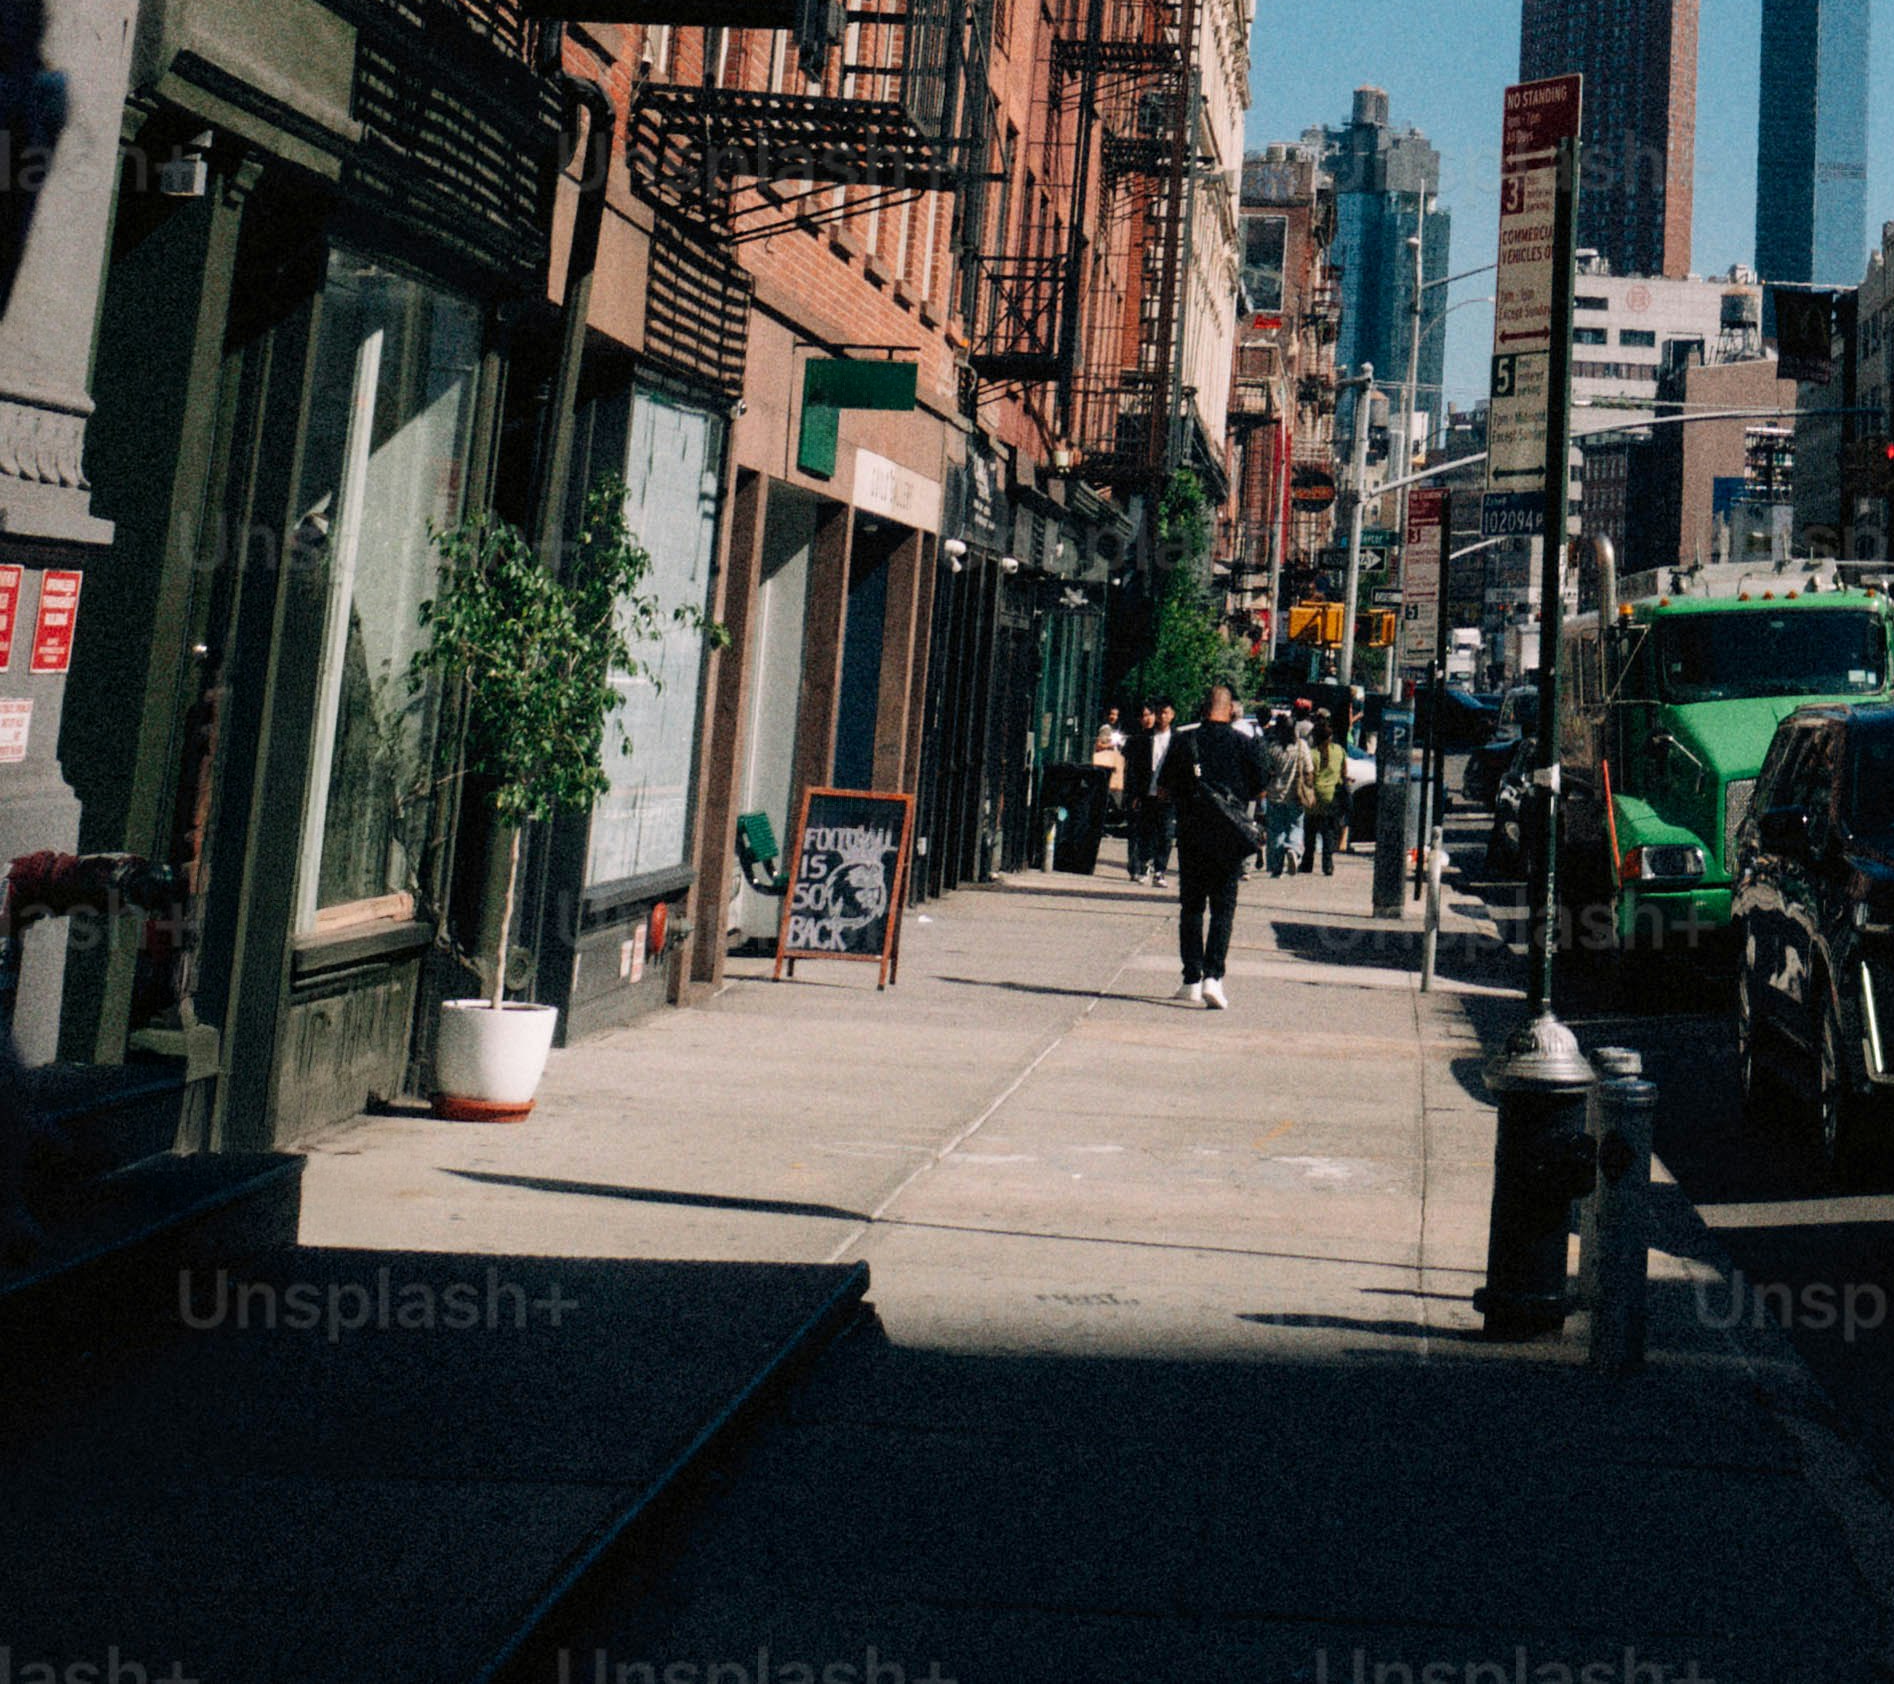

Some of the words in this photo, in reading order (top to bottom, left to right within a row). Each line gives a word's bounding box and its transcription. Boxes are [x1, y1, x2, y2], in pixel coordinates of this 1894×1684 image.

[1507, 92, 1520, 109] NO
[1522, 85, 1568, 107] STANDING
[1506, 178, 1519, 211] 3
[1502, 225, 1554, 246] COMMERCI
[1501, 246, 1543, 265] VEHICLES
[1497, 358, 1510, 393] 5
[1484, 509, 1533, 534] 102094
[800, 854, 828, 879] IS
[792, 882, 828, 911] SO
[786, 915, 848, 952] BACK
